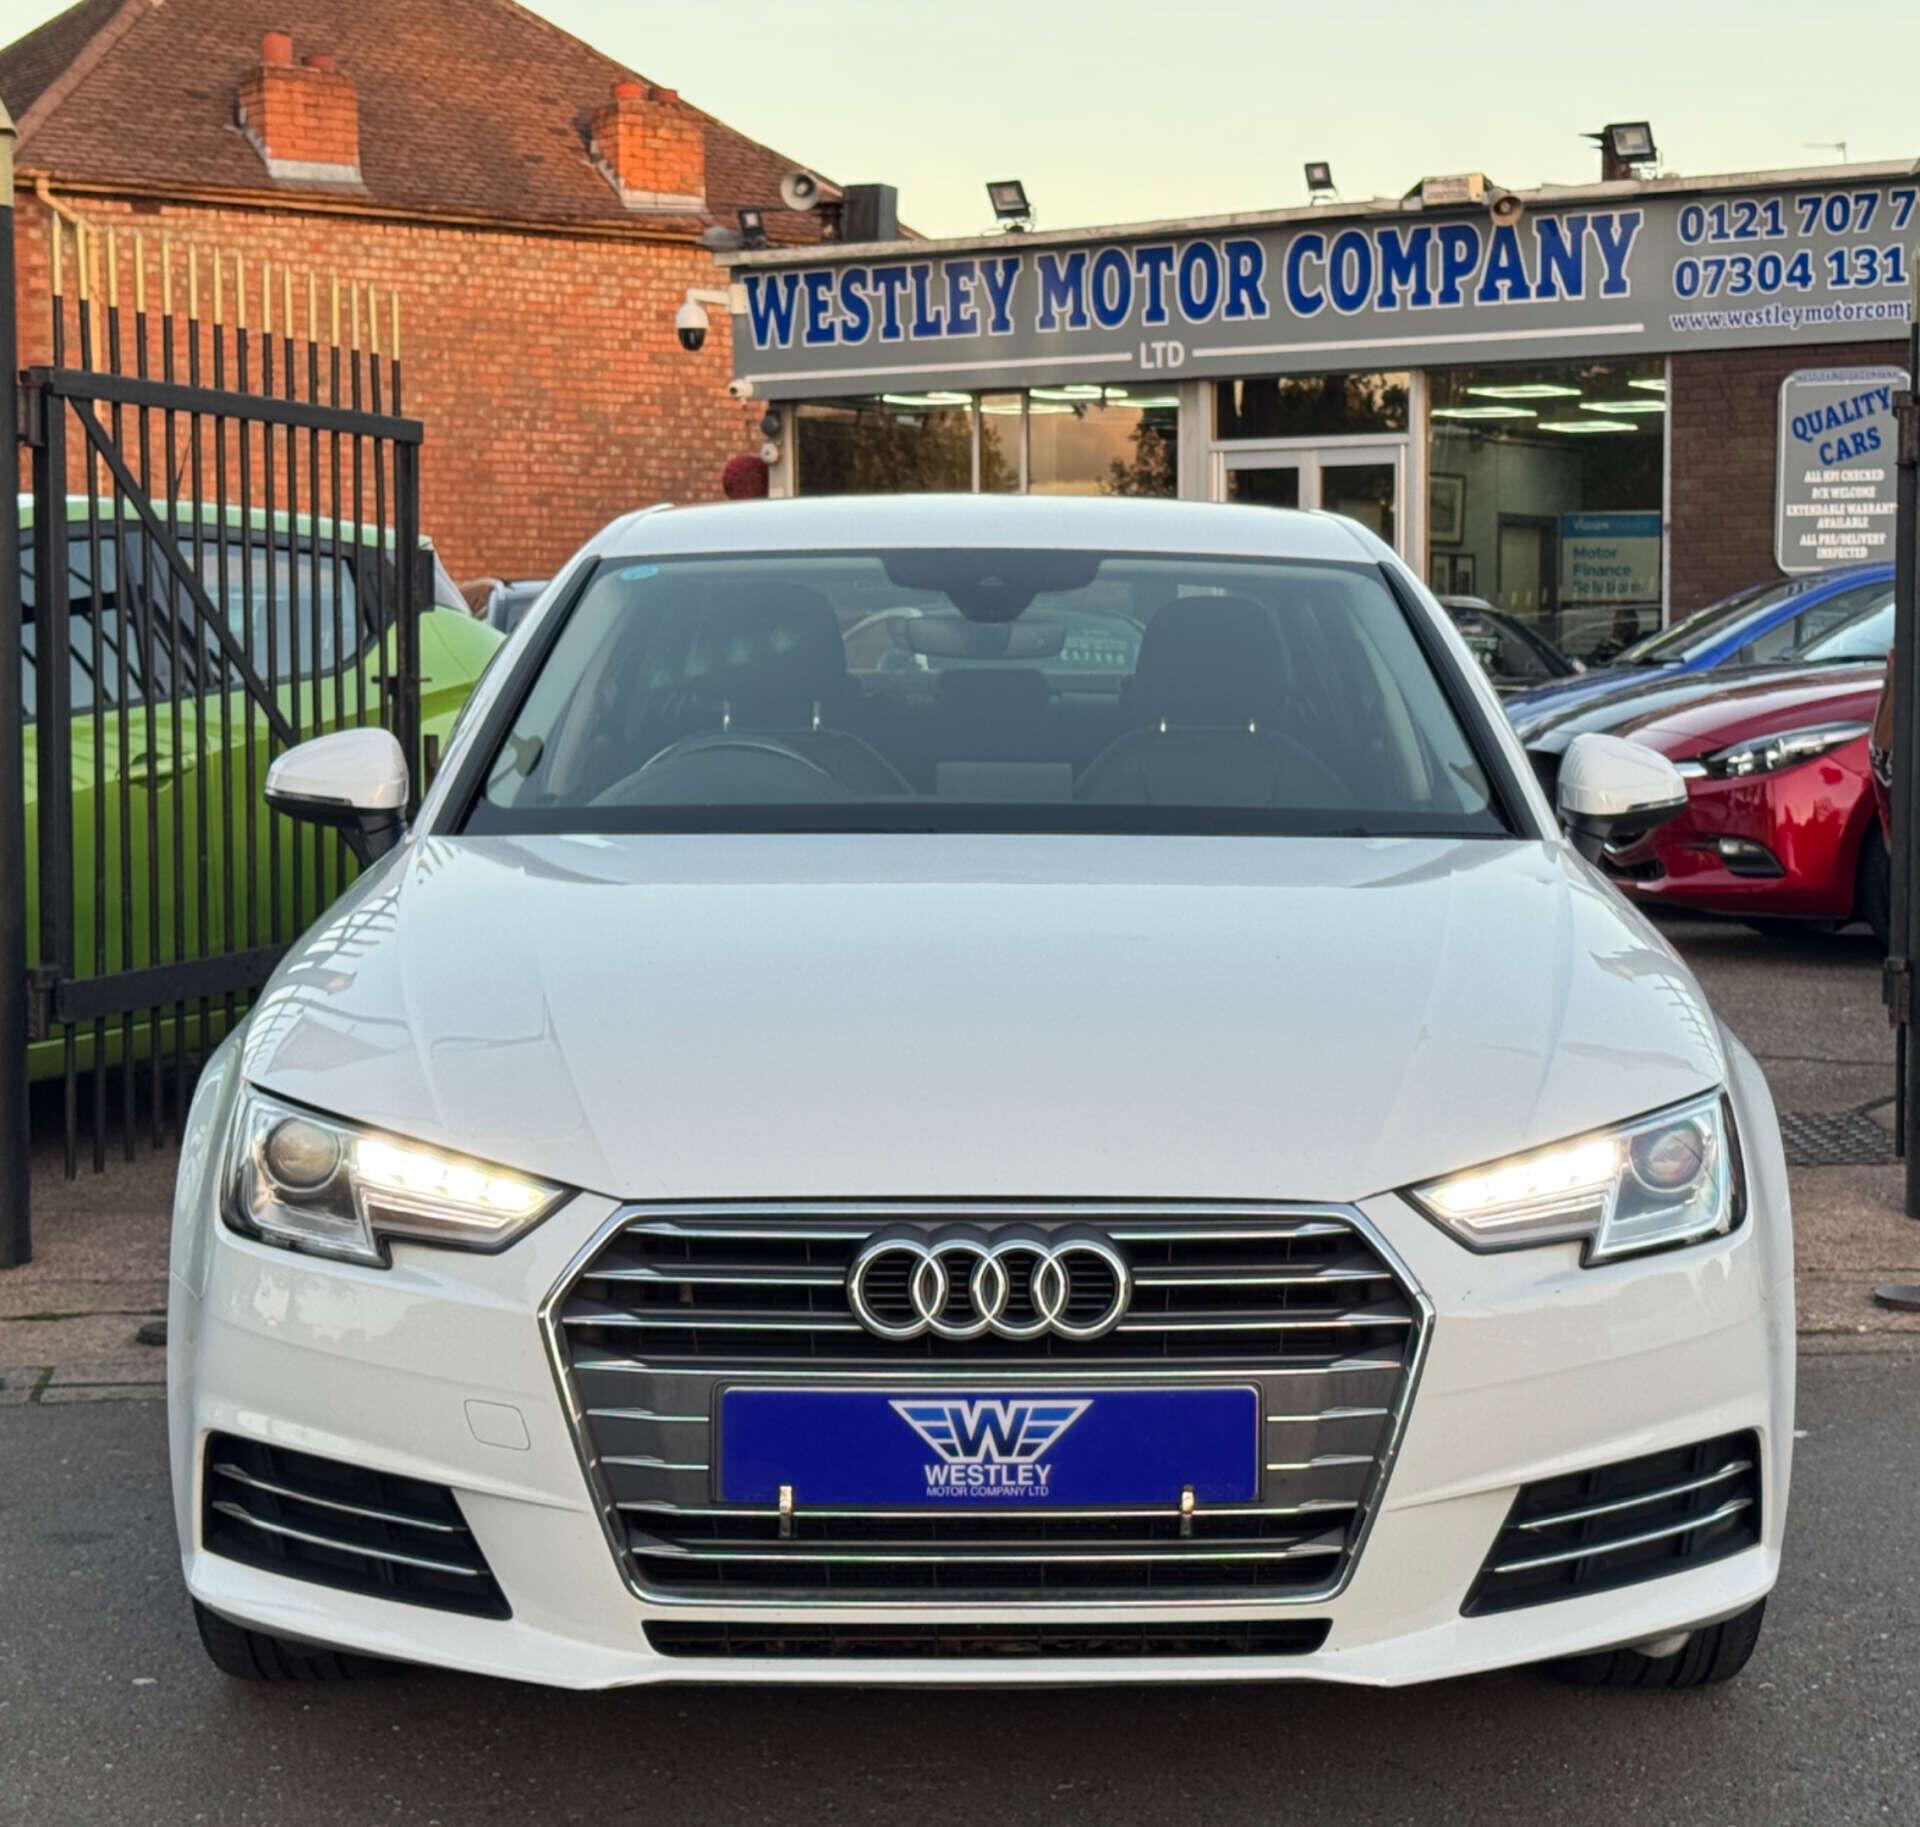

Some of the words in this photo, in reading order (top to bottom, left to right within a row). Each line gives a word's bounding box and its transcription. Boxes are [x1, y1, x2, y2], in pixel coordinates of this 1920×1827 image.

[1677, 197, 1787, 245] 0121
[1795, 189, 1881, 237] 707
[1888, 185, 1919, 231] 7
[740, 254, 1023, 350] WESTLEY
[1035, 237, 1269, 334] MOTOR
[1284, 209, 1645, 317] COMPANY
[1673, 251, 1816, 300] 07304
[1824, 243, 1909, 289] 131
[1140, 341, 1185, 369] LTD
[1792, 385, 1890, 442] QUALITY
[1819, 426, 1882, 466] CARS
[1803, 470, 1822, 482] ALL
[1841, 468, 1885, 481] CHECKED
[1817, 516, 1869, 528] AVAILABLE
[1800, 533, 1818, 545] ALL
[1572, 546, 1617, 560] Motor
[1572, 563, 1633, 577] Finance
[924, 1464, 1052, 1485] WESTLEY
[926, 1486, 968, 1497] MOTOR
[970, 1486, 1027, 1497] COMPANY
[1028, 1486, 1049, 1497] LTD
